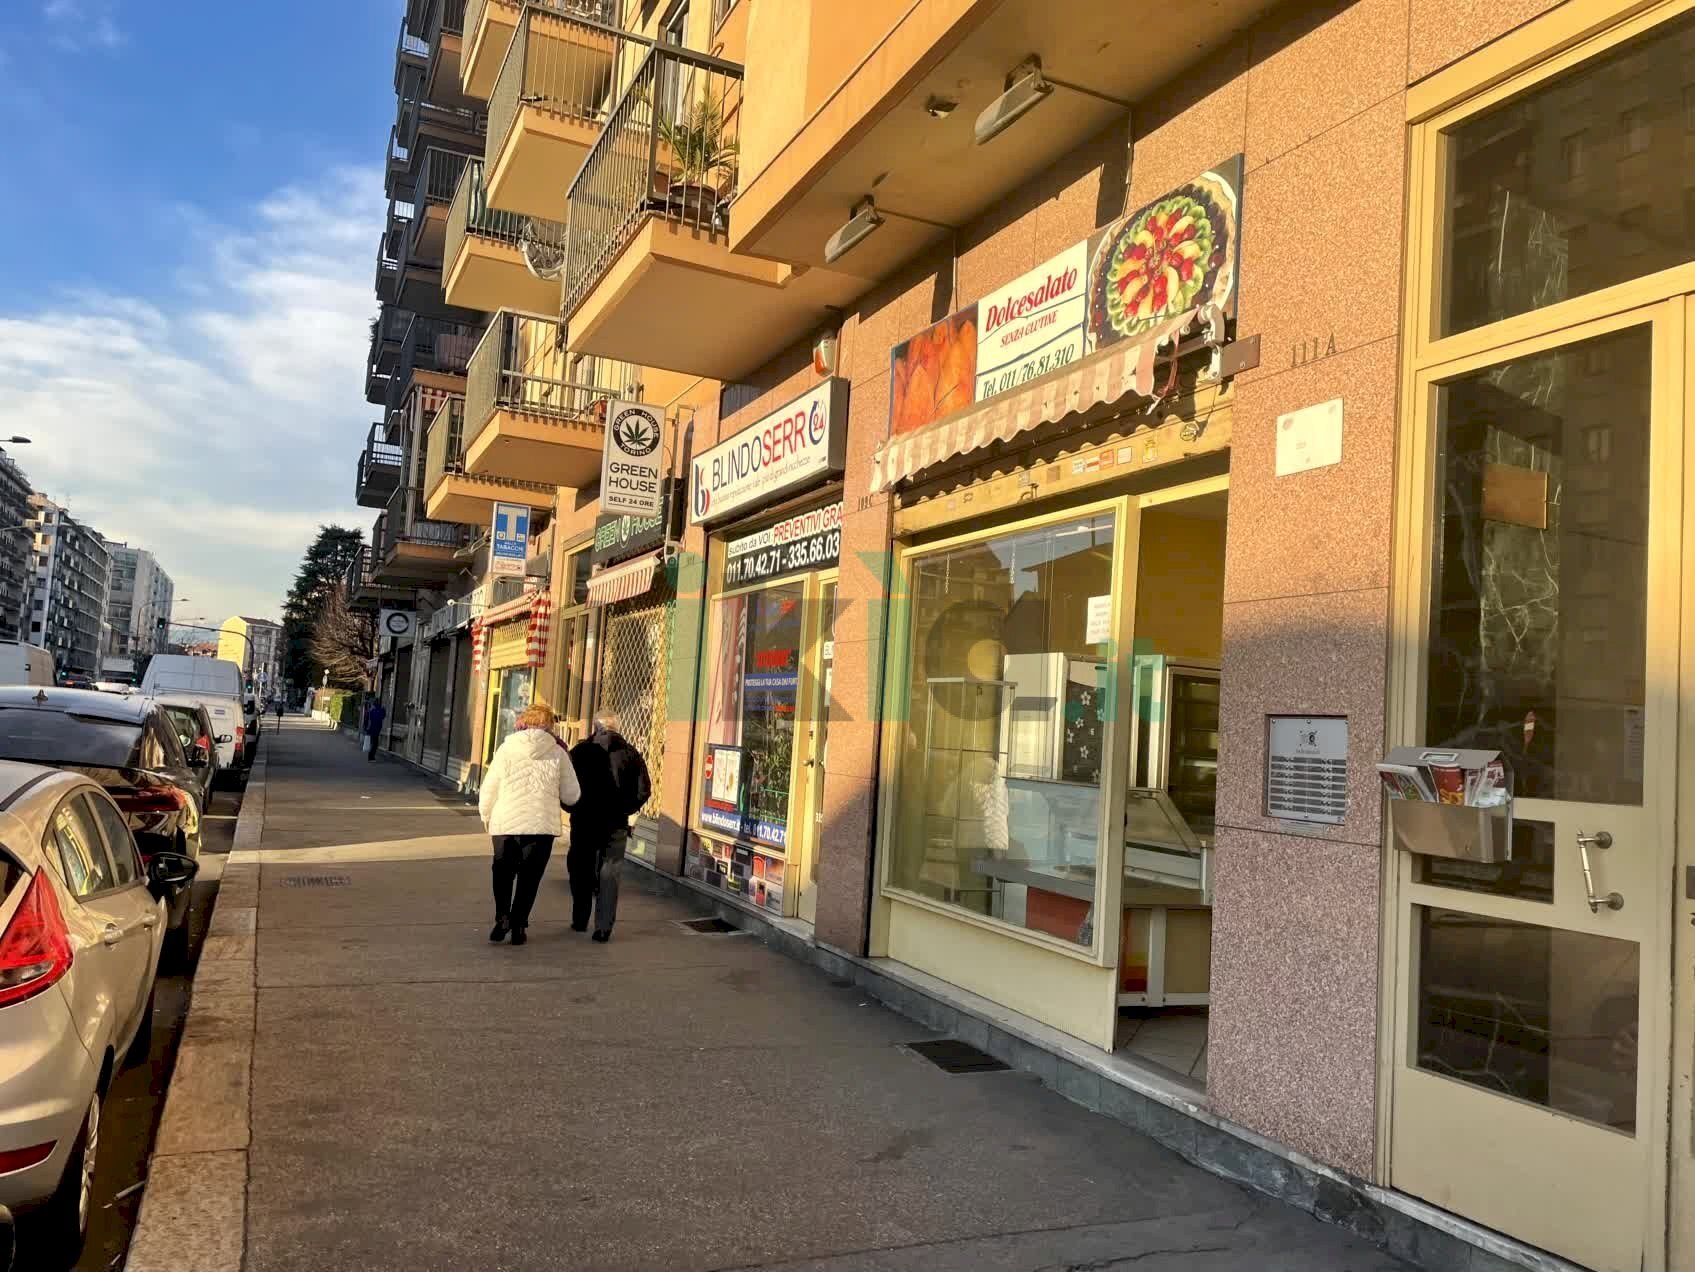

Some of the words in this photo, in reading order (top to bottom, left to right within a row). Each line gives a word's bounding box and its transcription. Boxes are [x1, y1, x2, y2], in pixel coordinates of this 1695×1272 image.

[985, 265, 1078, 333] Dolcesalato
[1000, 324, 1025, 348] SENZA
[1025, 310, 1058, 337] GLUTINE
[983, 379, 998, 399] Tel.
[999, 343, 1075, 391] 011/76.81.310
[613, 408, 637, 432] GREEN
[640, 409, 660, 438] HOUSE
[620, 443, 652, 456] TORINO
[712, 410, 806, 492] BLINDOSERR
[608, 476, 657, 493] HOUSE
[609, 461, 658, 479] GREEN
[608, 495, 627, 504] SELF
[639, 500, 655, 508] ORE
[748, 539, 757, 550] da
[773, 512, 821, 542] PREVENTIVI
[726, 548, 781, 584] 011.70.42.71
[788, 532, 840, 568] 335.66.03
